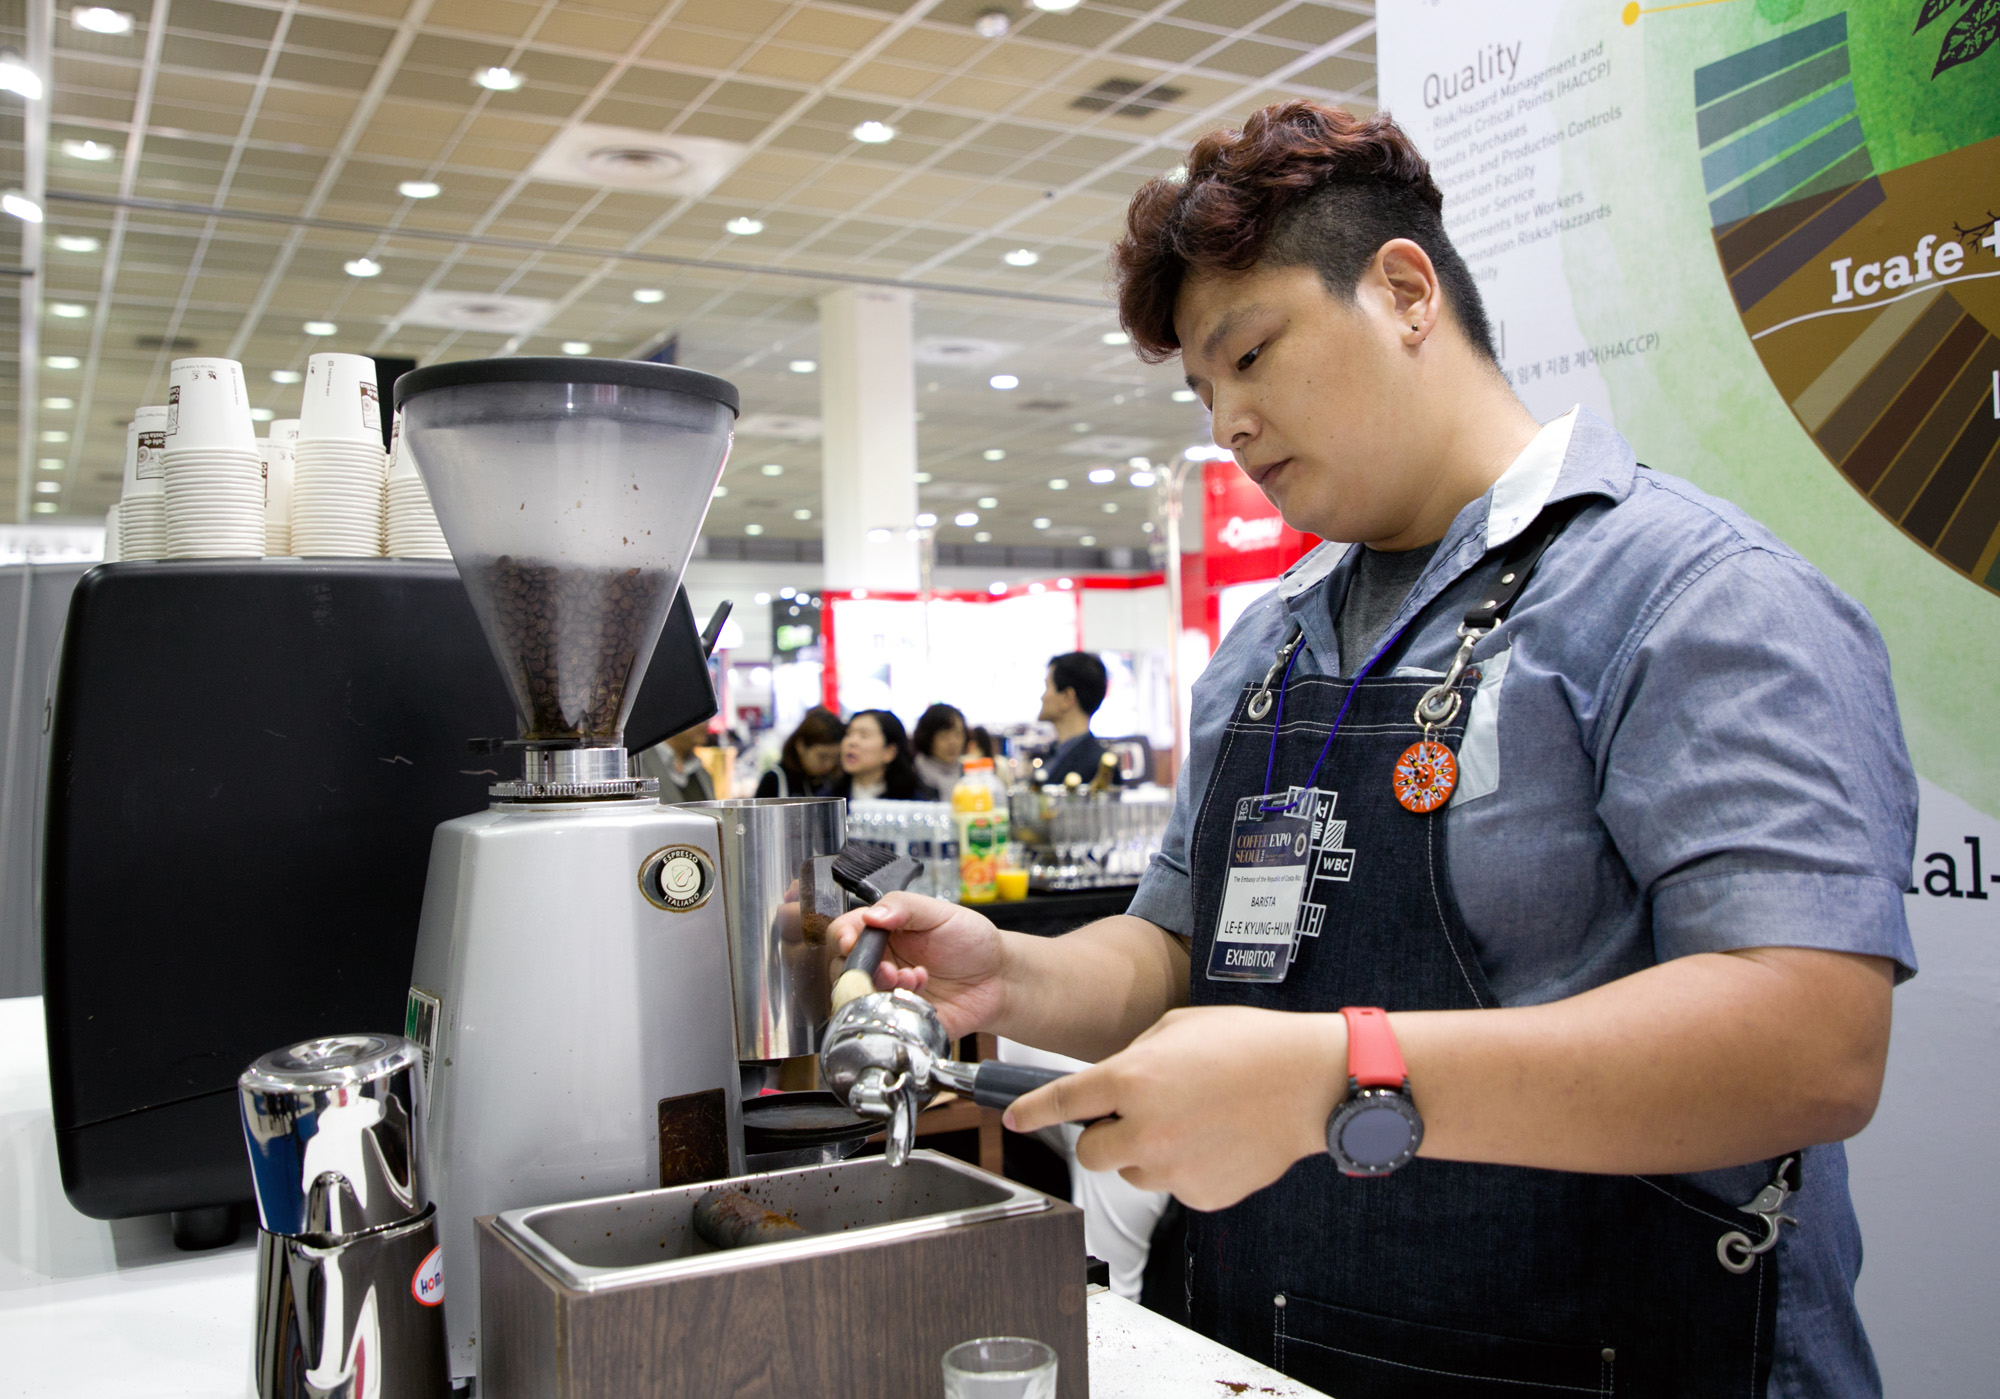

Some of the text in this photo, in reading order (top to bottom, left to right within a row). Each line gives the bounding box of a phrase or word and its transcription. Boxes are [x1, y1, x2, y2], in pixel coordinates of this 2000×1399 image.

[1423, 40, 1521, 109] Quality
[1433, 40, 1604, 130] Risk/Hazard Management and
[1433, 58, 1612, 152] Control Critical Points (HACCP)
[1438, 104, 1622, 189] rocess and Production Controls
[1469, 124, 1528, 157] Purchases
[1443, 163, 1535, 210] roduction Facility
[1443, 208, 1478, 229] roduct
[1493, 186, 1536, 212] Service
[1514, 208, 1531, 227] for
[1532, 190, 1585, 218] Workers
[1465, 202, 1612, 263] mination Risks/Hazzards
[1830, 234, 1964, 304] Icafe
[662, 850, 698, 864] ESPRESSO
[1235, 849, 1261, 863] SEOUL
[1237, 832, 1291, 849] COFFEE EXPO
[1323, 857, 1350, 872] WBC
[664, 893, 699, 907] ITALIANO
[1251, 896, 1276, 907] BARISTA
[1225, 921, 1292, 936] LE-E KYUNG-HUN
[1225, 949, 1276, 968] EXHIBITOR
